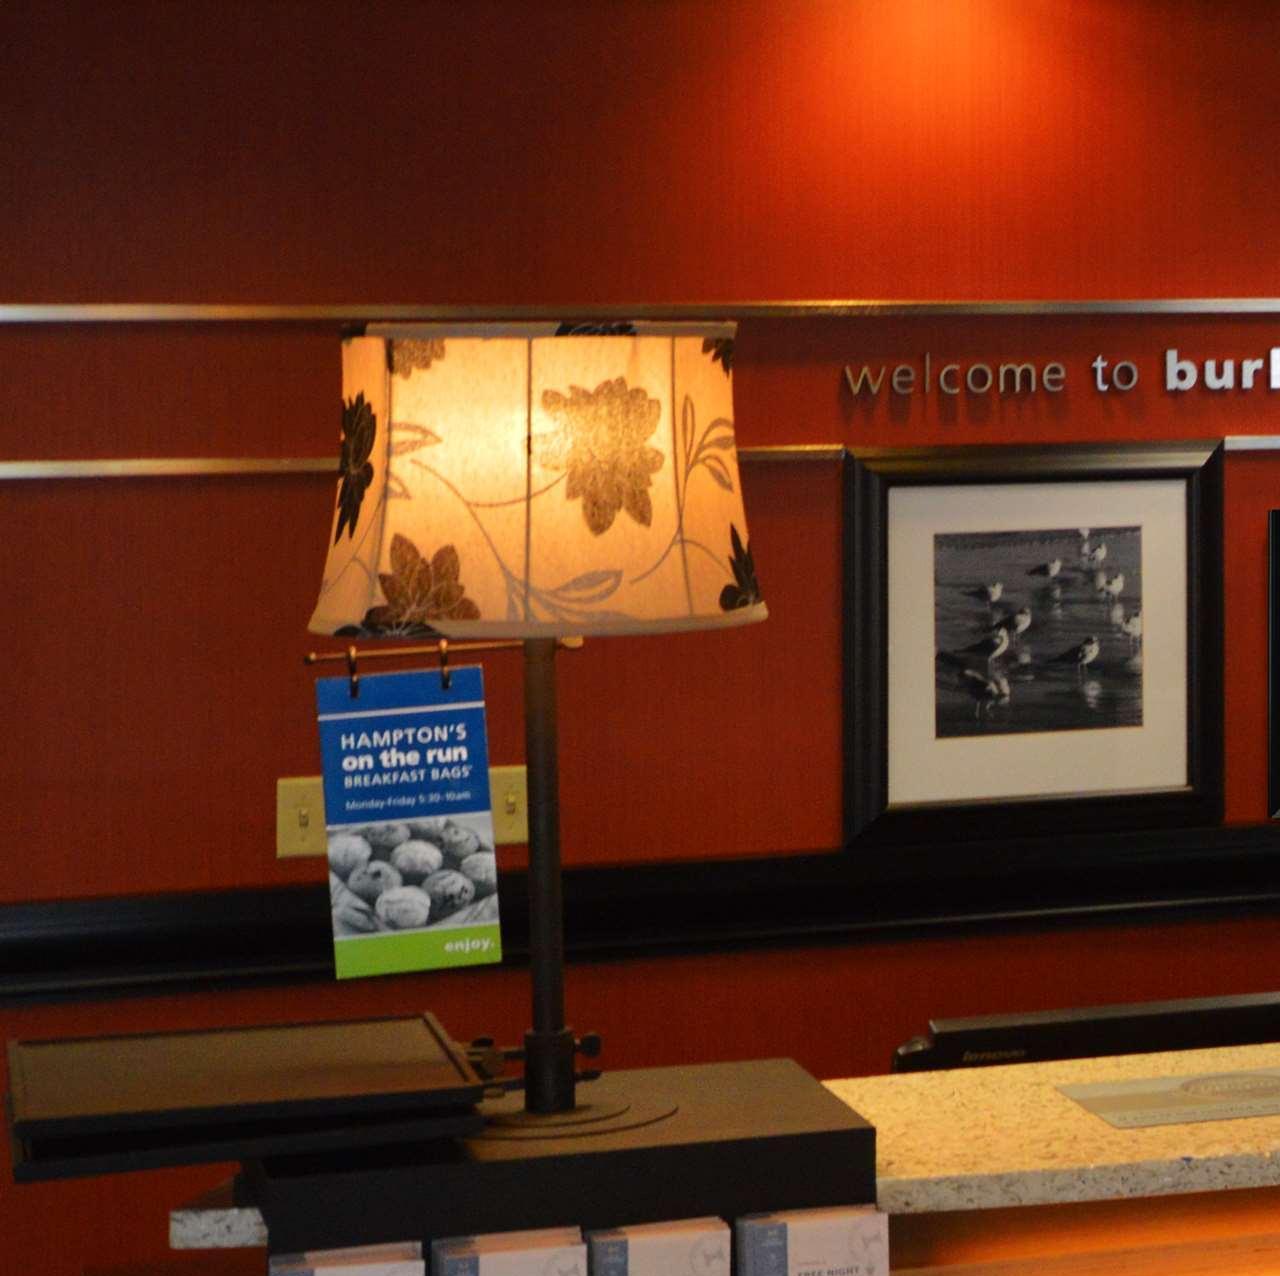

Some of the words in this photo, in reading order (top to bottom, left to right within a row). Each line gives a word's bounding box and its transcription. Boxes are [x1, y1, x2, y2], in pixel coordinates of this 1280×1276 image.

[845, 352, 1066, 394] welcome
[1093, 354, 1139, 391] to
[341, 722, 468, 751] HAMPTON'S
[342, 753, 374, 772] on
[379, 748, 421, 769] the
[426, 745, 468, 765] run
[344, 768, 426, 789] BREAKFAST
[827, 1265, 861, 1276] NIGHT
